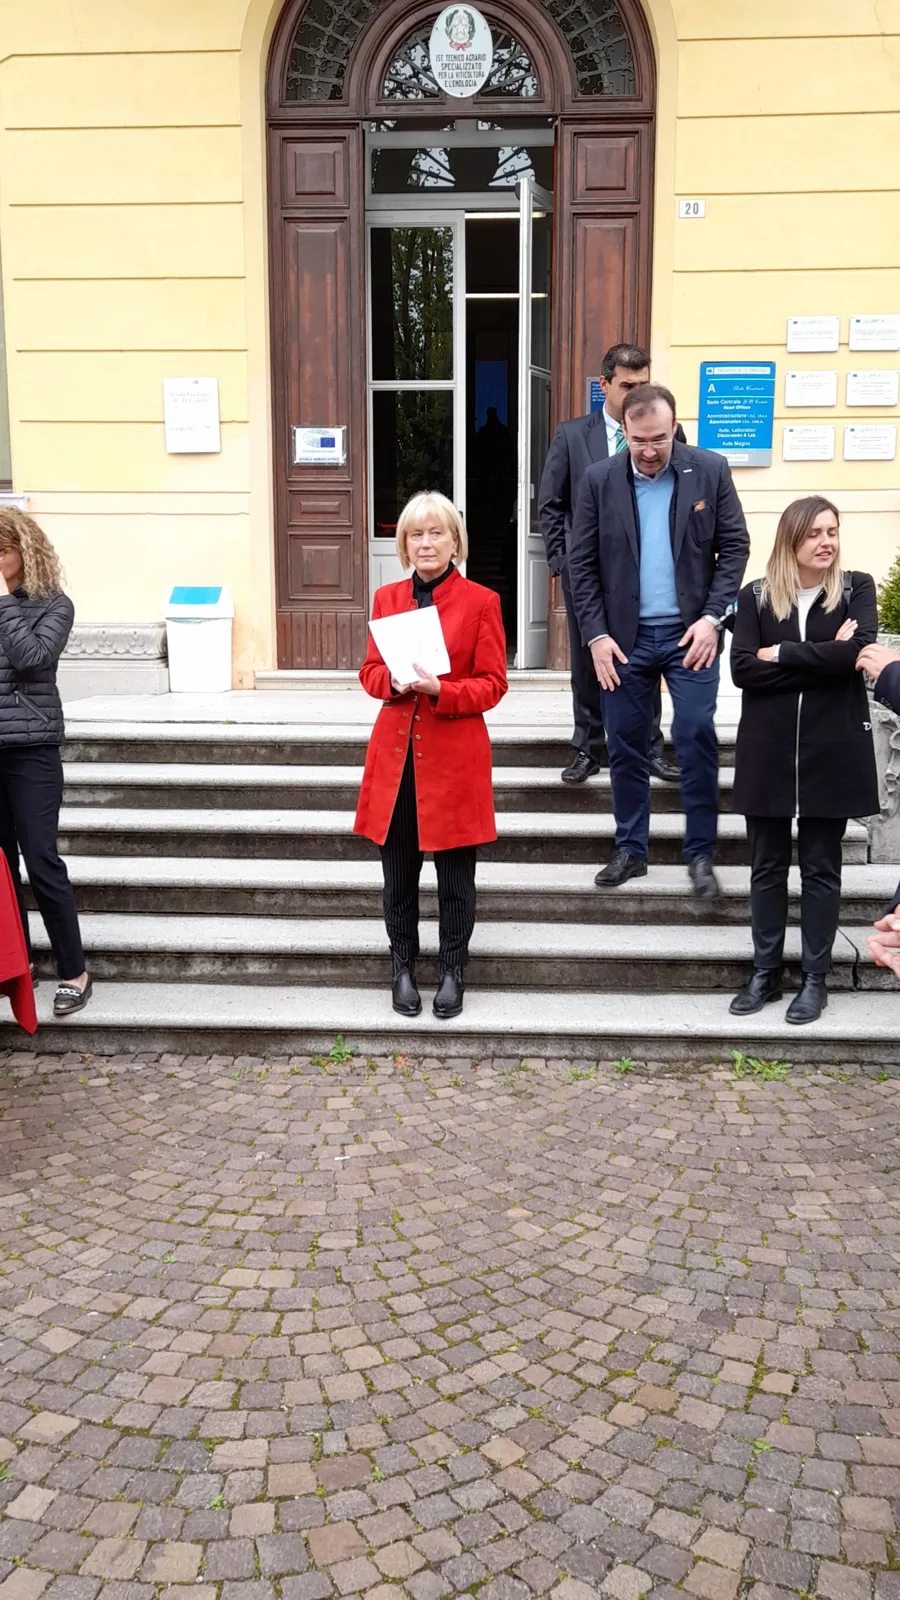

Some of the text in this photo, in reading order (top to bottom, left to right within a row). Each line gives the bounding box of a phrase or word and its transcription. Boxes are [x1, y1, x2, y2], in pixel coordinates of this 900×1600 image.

[466, 53, 487, 61] AGRARIO
[441, 62, 482, 70] SPECIALIZZATO
[438, 71, 447, 79] PER
[685, 202, 699, 215] 20
[707, 383, 716, 393] A
